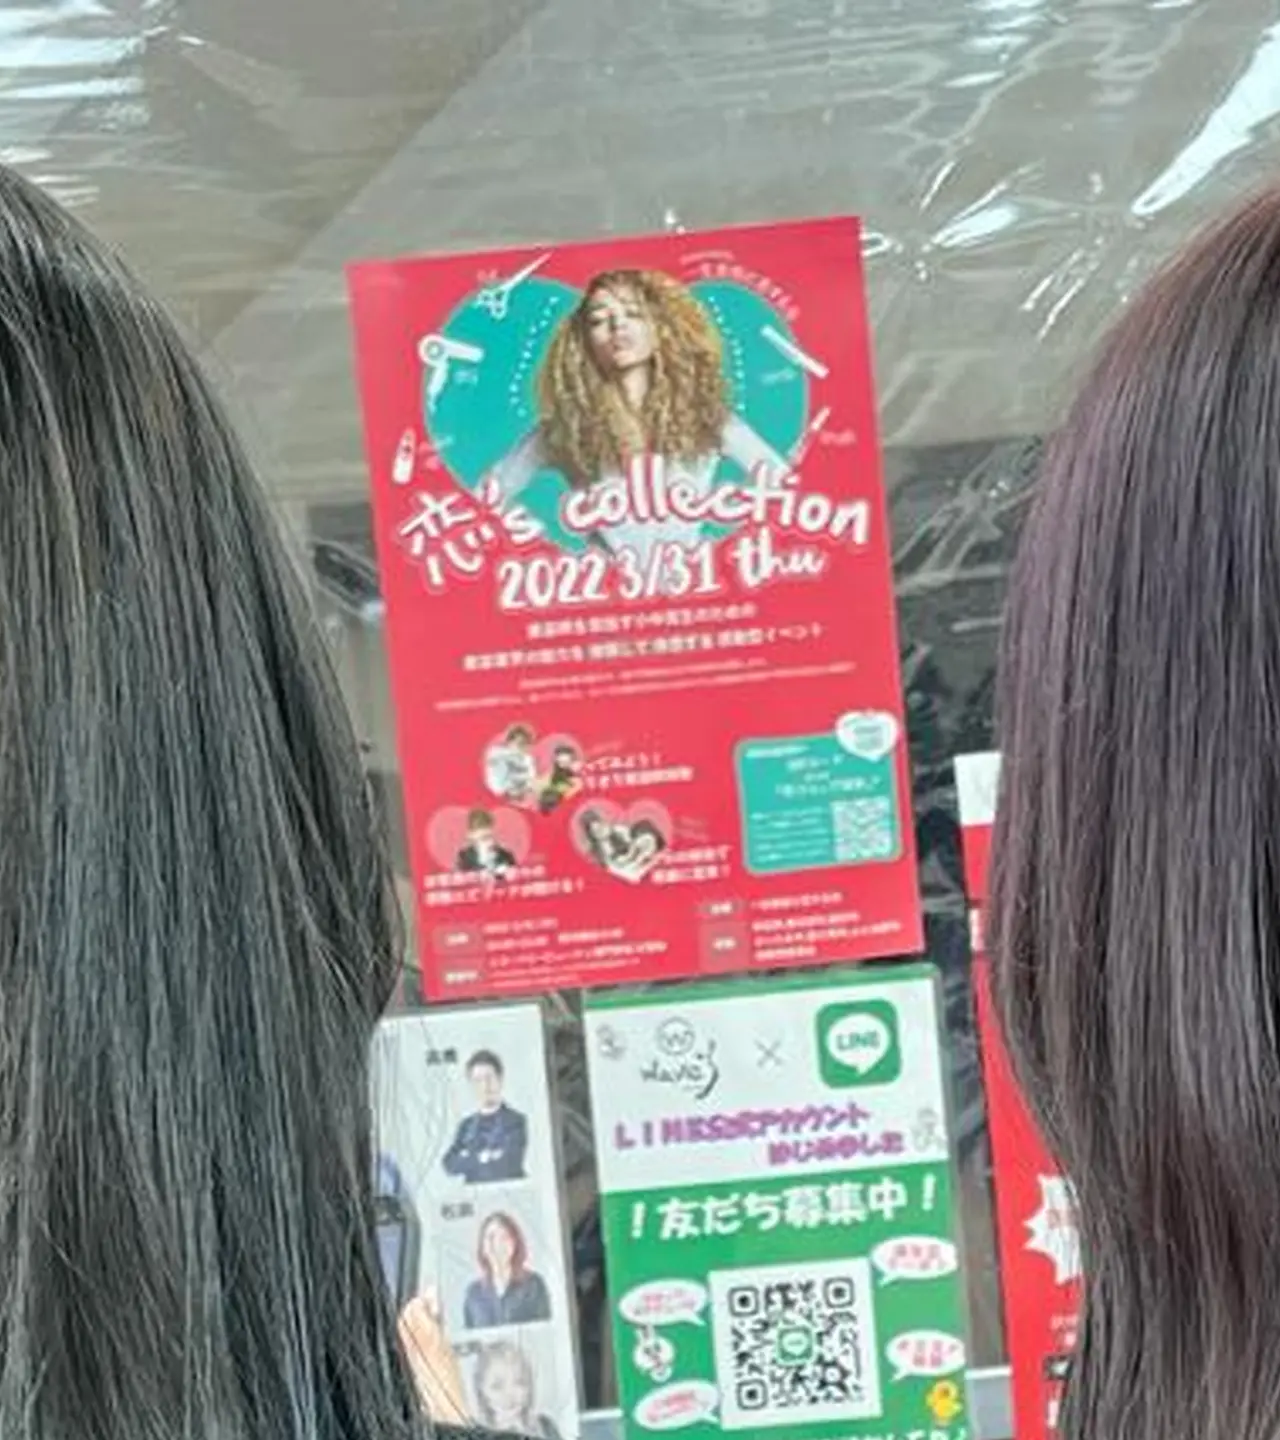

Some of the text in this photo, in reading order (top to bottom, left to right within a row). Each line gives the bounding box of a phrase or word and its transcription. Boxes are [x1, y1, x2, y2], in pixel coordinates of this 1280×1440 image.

[563, 462, 869, 546] collection
[497, 528, 823, 609] 2022 3/31 thu
[835, 1030, 880, 1051] LINE
